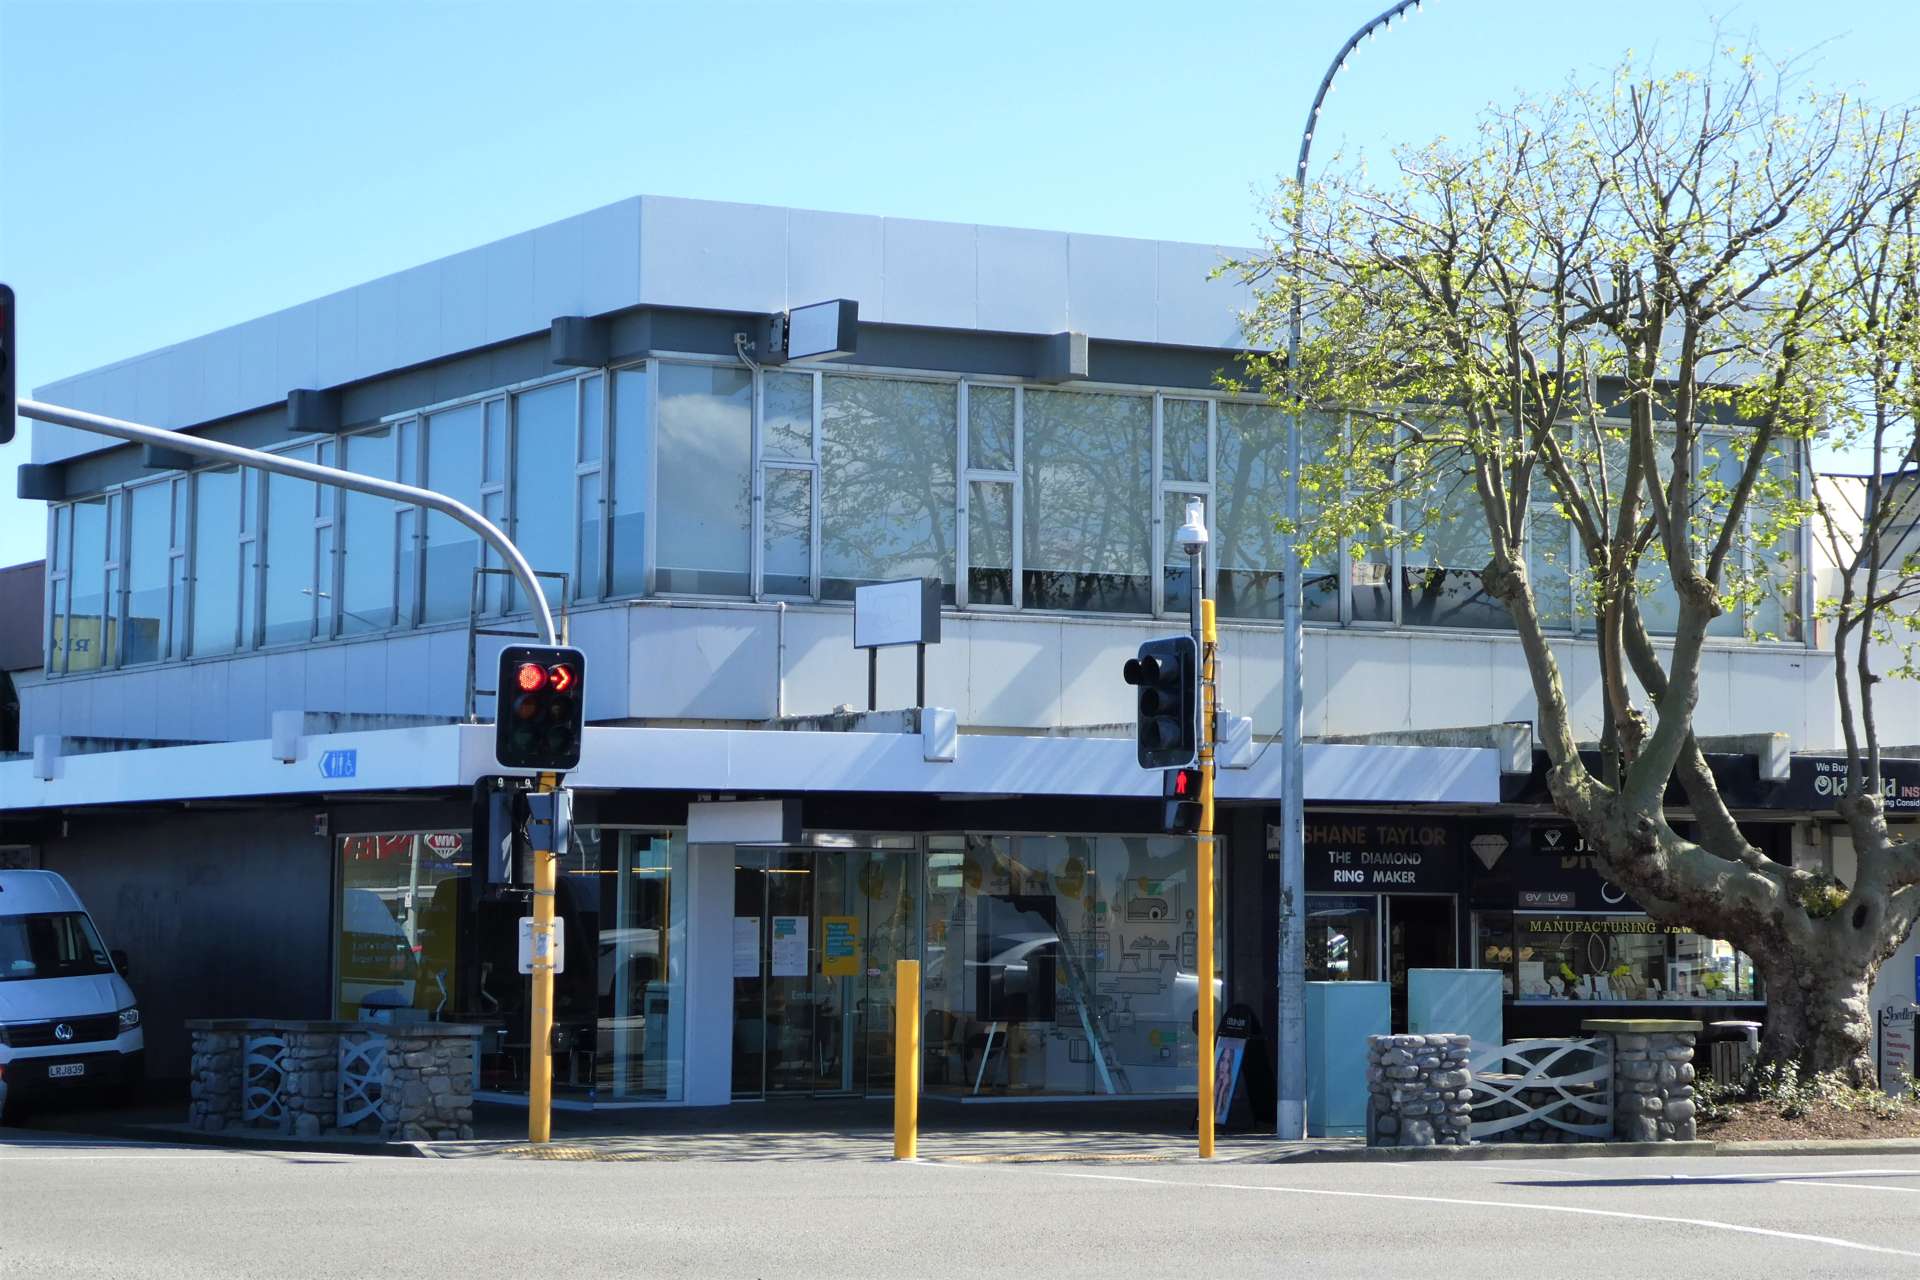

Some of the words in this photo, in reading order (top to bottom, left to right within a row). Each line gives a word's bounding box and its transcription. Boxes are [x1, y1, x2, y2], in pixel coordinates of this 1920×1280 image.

[1816, 763, 1829, 772] We
[1833, 763, 1848, 773] Buy
[1304, 825, 1367, 846] SHANE
[1377, 826, 1448, 847] TAYLOR
[1328, 851, 1351, 864] THE
[1361, 852, 1422, 866] DIAMOND
[1334, 870, 1365, 884] RING
[1373, 871, 1416, 885] MAKER
[1530, 920, 1657, 934] MANUFACTURING
[50, 1064, 83, 1076] LRJ839
